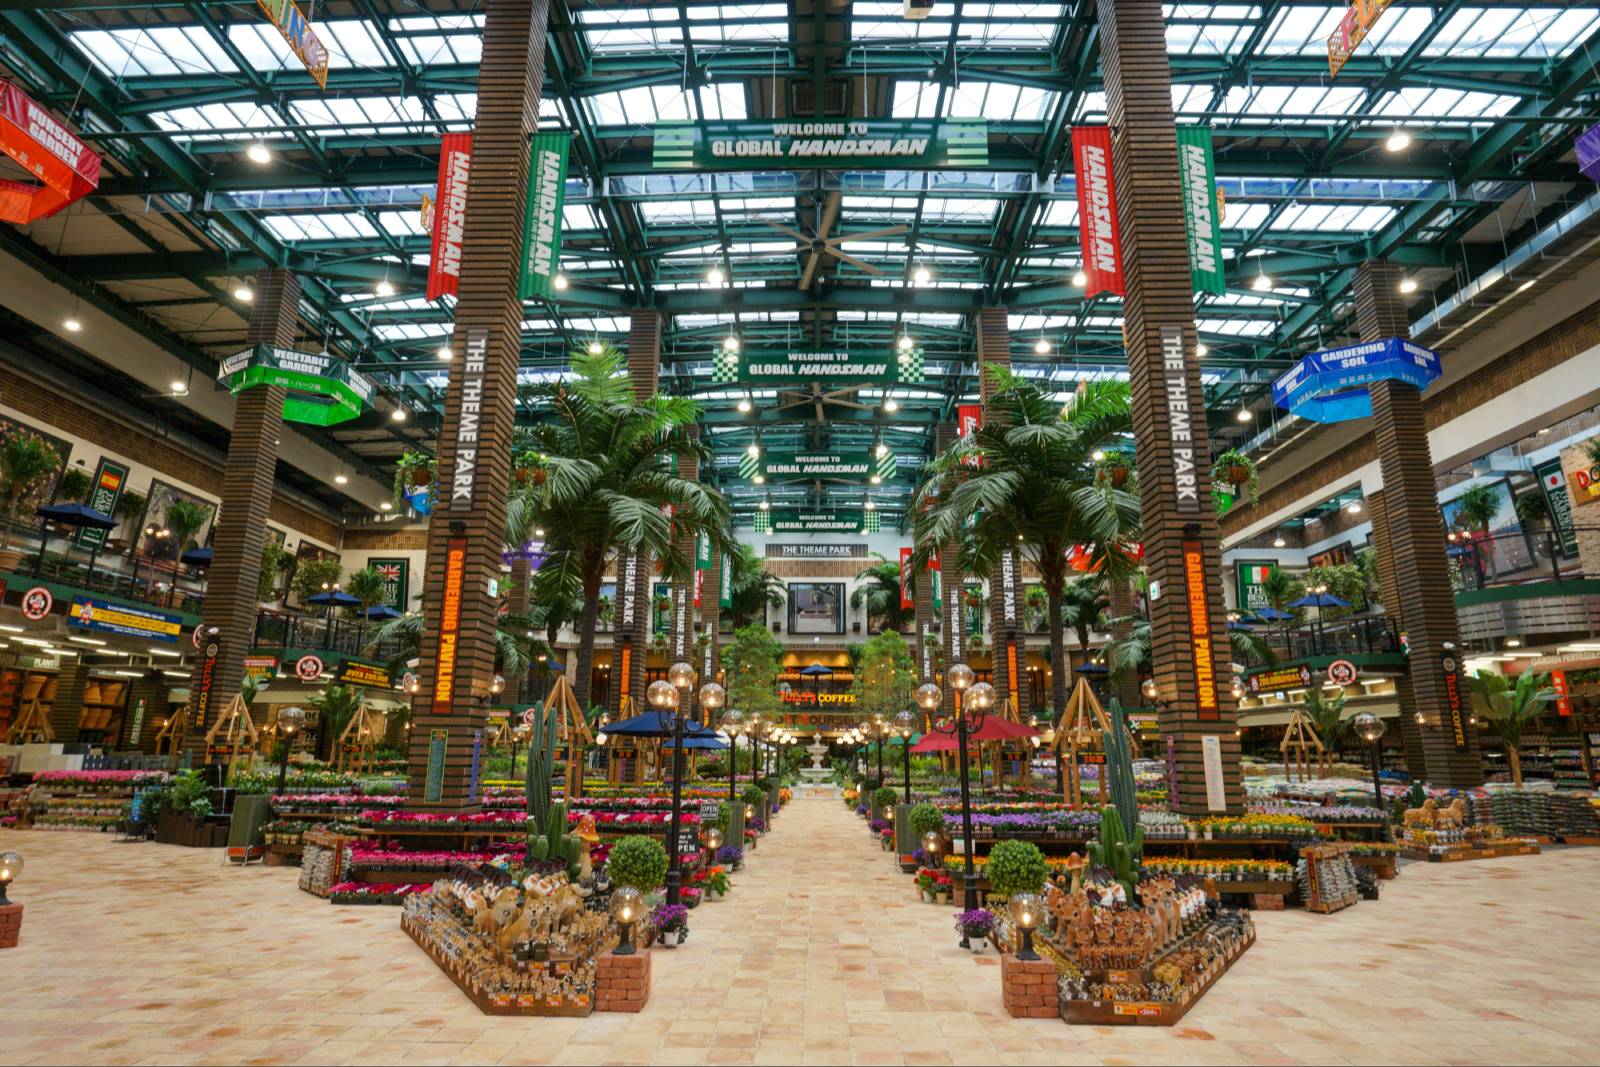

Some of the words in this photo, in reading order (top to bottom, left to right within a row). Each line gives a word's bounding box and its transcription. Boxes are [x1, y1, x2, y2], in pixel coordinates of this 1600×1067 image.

[28, 104, 83, 156] NURSERY
[773, 123, 844, 136] WELCOME
[848, 123, 868, 136] TO
[29, 121, 78, 169] GARDEN
[712, 140, 783, 156] GLOBAL
[788, 139, 928, 156] HANDSMAN
[443, 151, 470, 277] HANDSMAN
[534, 150, 561, 277] HANDSMAN
[1087, 144, 1116, 273] HANDSMAN
[1187, 144, 1216, 273] HANDSMAN
[273, 348, 330, 368] VEGETABLE
[279, 359, 322, 375] GARDEN
[466, 338, 486, 372] THE
[788, 353, 834, 361] WELCOME
[836, 353, 848, 361] TO
[1162, 335, 1184, 370] THE
[1320, 342, 1386, 363] GARDENING
[1341, 356, 1368, 369] SOIL
[749, 364, 794, 375] GLOBAL
[798, 363, 887, 375] HANDSMAN
[459, 378, 482, 443] THEME
[1166, 376, 1191, 442] THEME
[452, 449, 476, 500] PARK
[766, 465, 800, 473] GLOBAL
[802, 464, 868, 473] HANDSMAN
[1173, 448, 1197, 500] PARK
[783, 546, 797, 554] THE
[799, 546, 826, 554] THEME
[829, 546, 851, 554] PARK
[624, 555, 637, 593] THEME
[1002, 551, 1015, 589] THEME
[443, 550, 463, 631] GARDENING
[677, 588, 686, 604] THE
[950, 588, 959, 604] THE
[1186, 552, 1208, 635] GARDENING
[623, 595, 635, 624] PARK
[677, 606, 686, 636] THEME
[950, 606, 960, 636] THEME
[1003, 591, 1016, 621] PARK
[675, 638, 685, 657] PARK
[951, 638, 960, 657] PARK
[436, 634, 456, 701] PAVILION
[1194, 639, 1215, 708] PAVILION
[817, 693, 857, 703] COFFEE
[1451, 708, 1465, 747] COFFEE
[702, 805, 718, 813] OPEN
